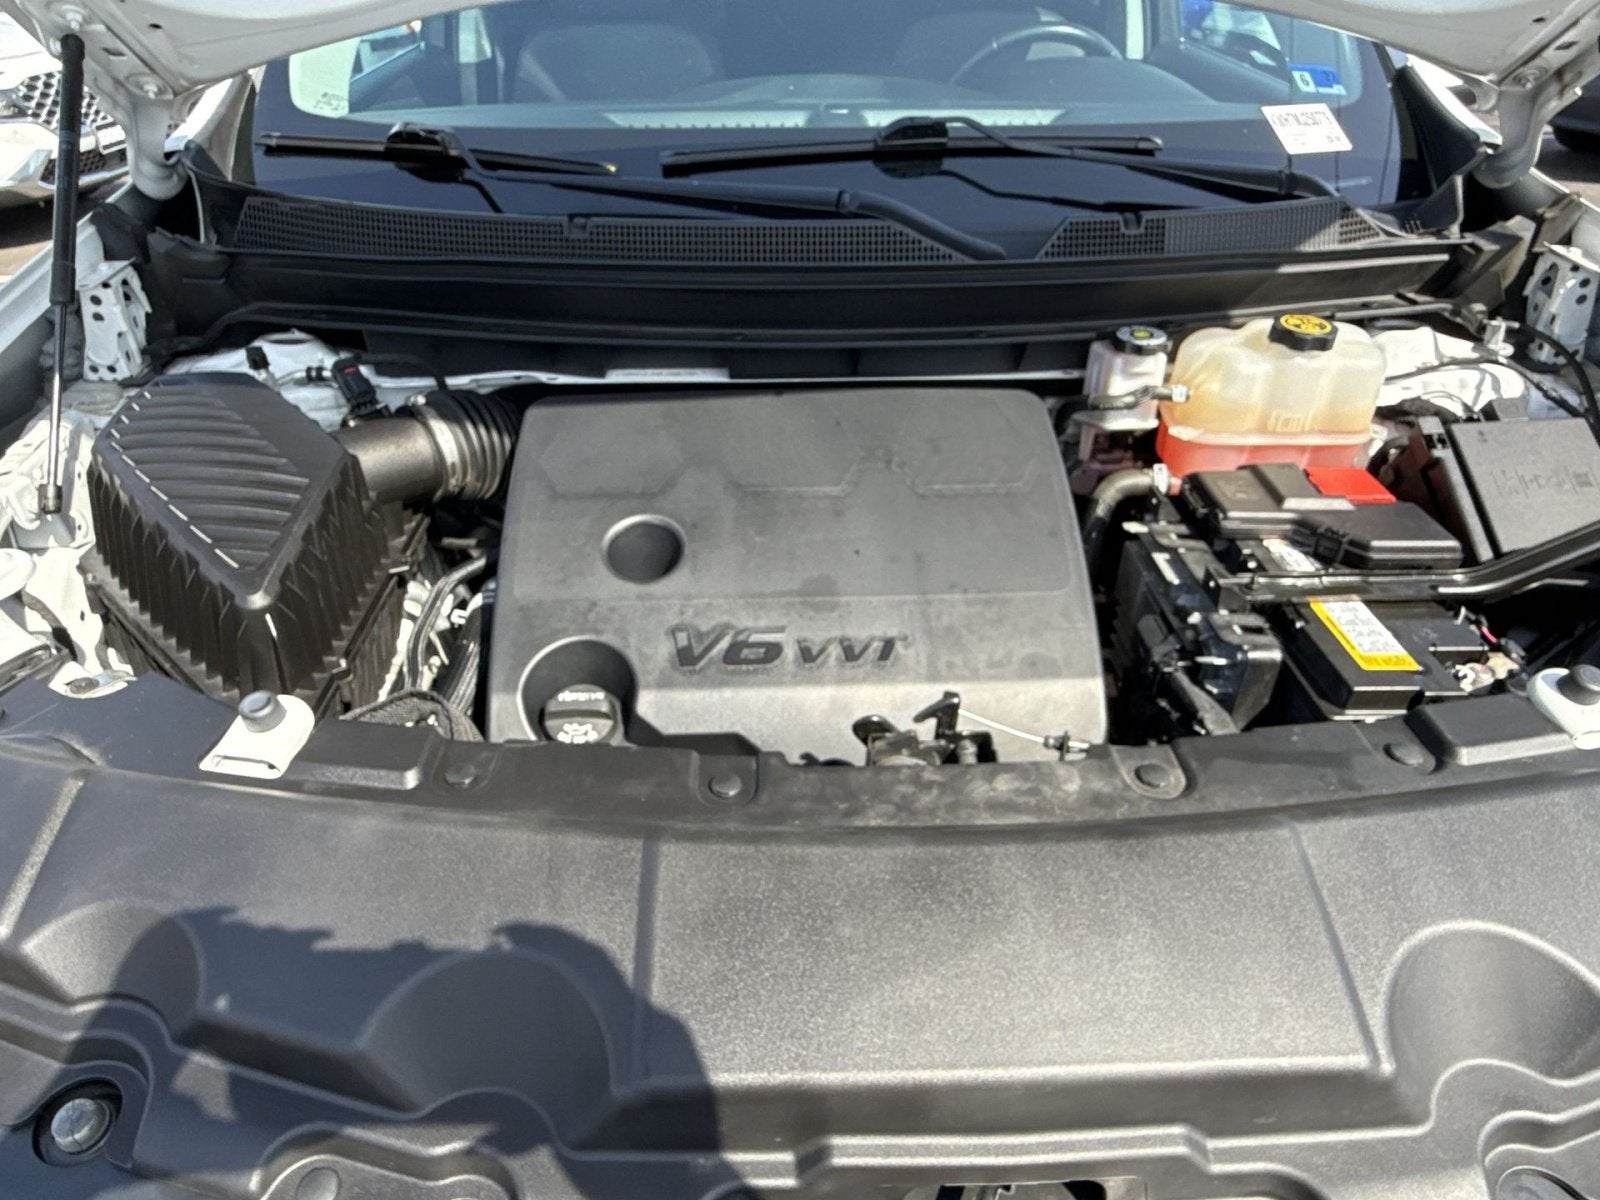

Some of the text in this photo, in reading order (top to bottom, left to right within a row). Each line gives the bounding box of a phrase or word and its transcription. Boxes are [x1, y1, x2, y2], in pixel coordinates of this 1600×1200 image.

[1299, 72, 1310, 87] 6
[668, 624, 908, 673] V6 VVT
